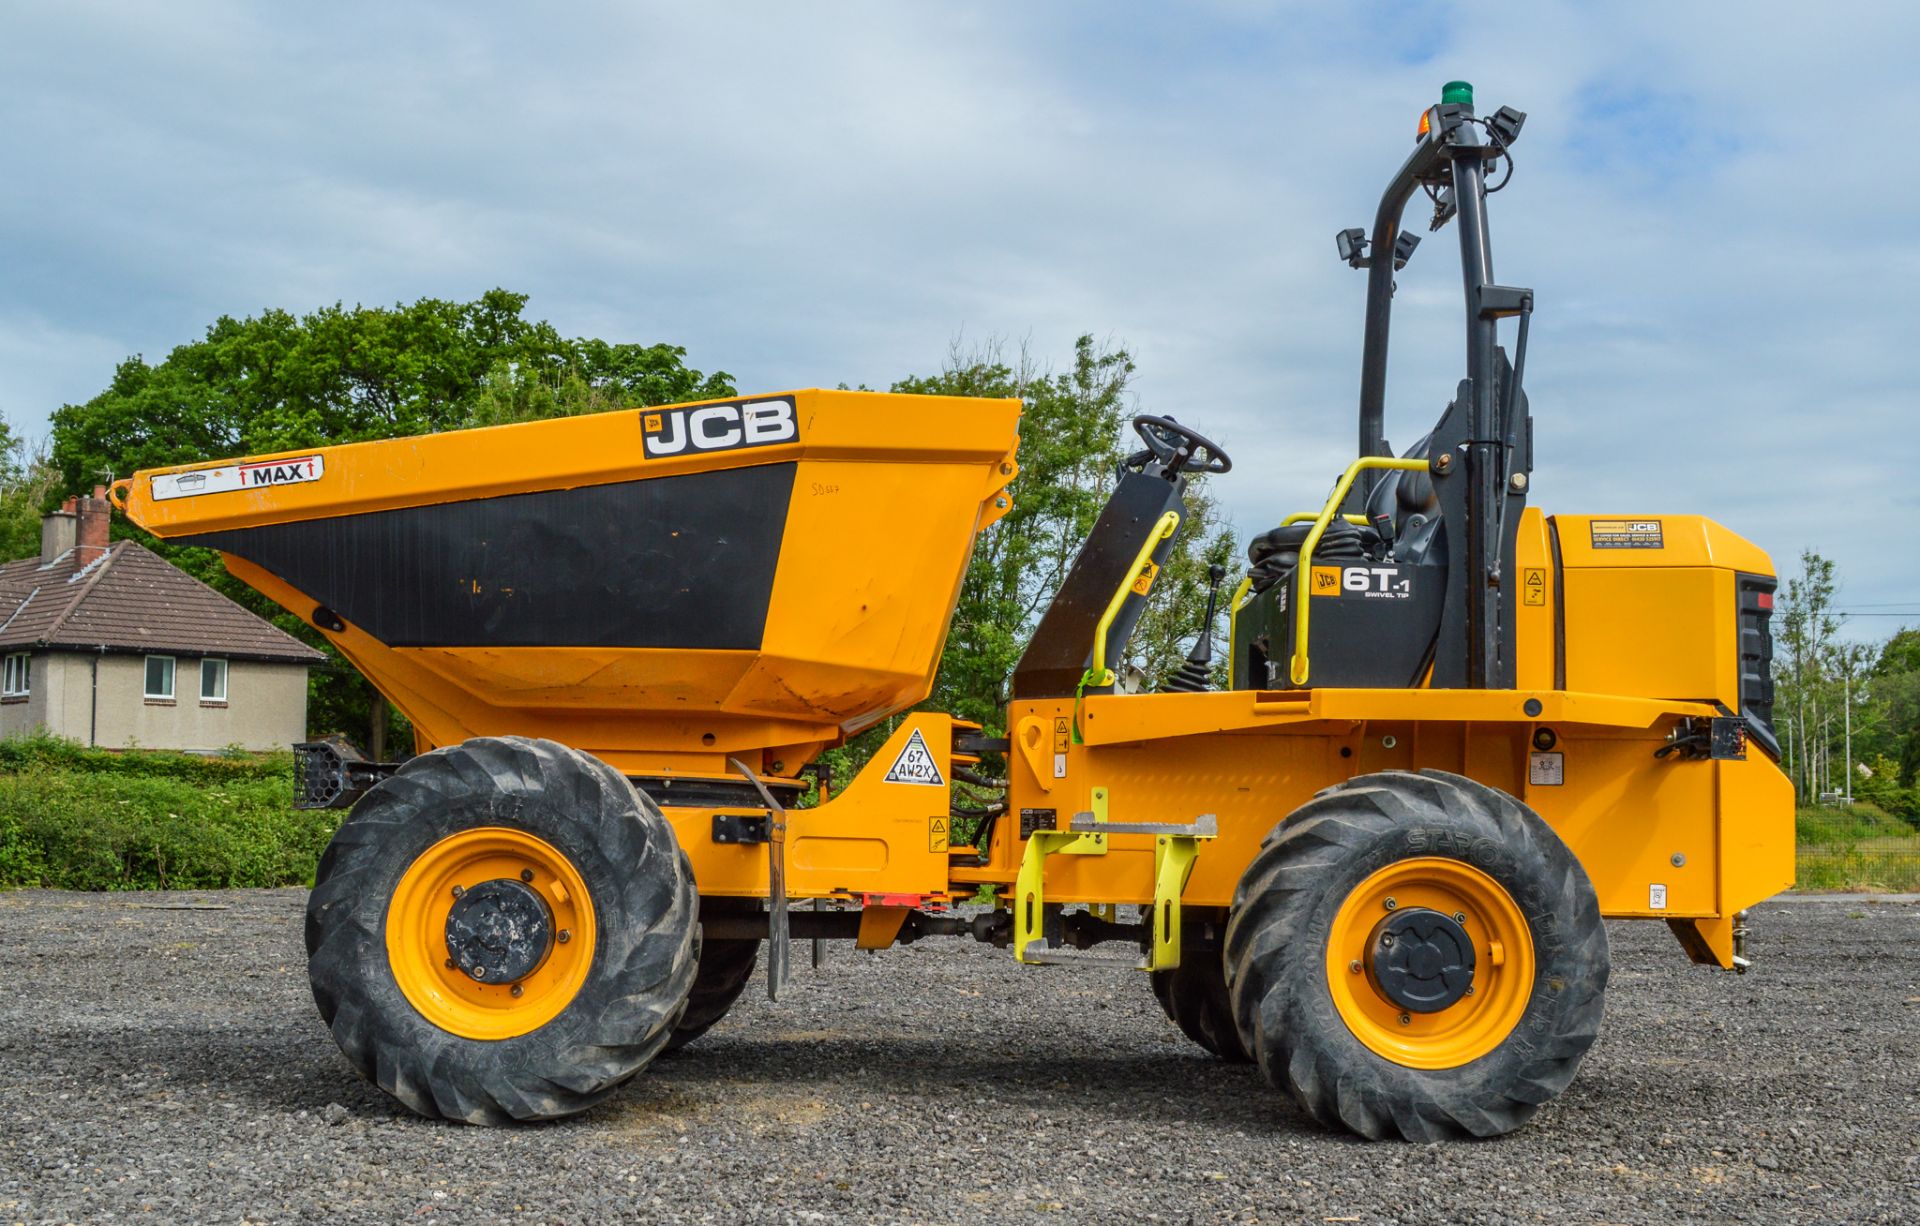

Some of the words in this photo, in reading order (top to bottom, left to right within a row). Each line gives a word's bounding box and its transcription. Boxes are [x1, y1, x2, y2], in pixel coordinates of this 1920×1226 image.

[646, 400, 795, 454] JCB
[253, 464, 304, 485] MAX
[1628, 523, 1657, 531] JCB
[1318, 574, 1337, 588] JCB
[907, 750, 924, 763] 67
[898, 763, 931, 778] AW2X
